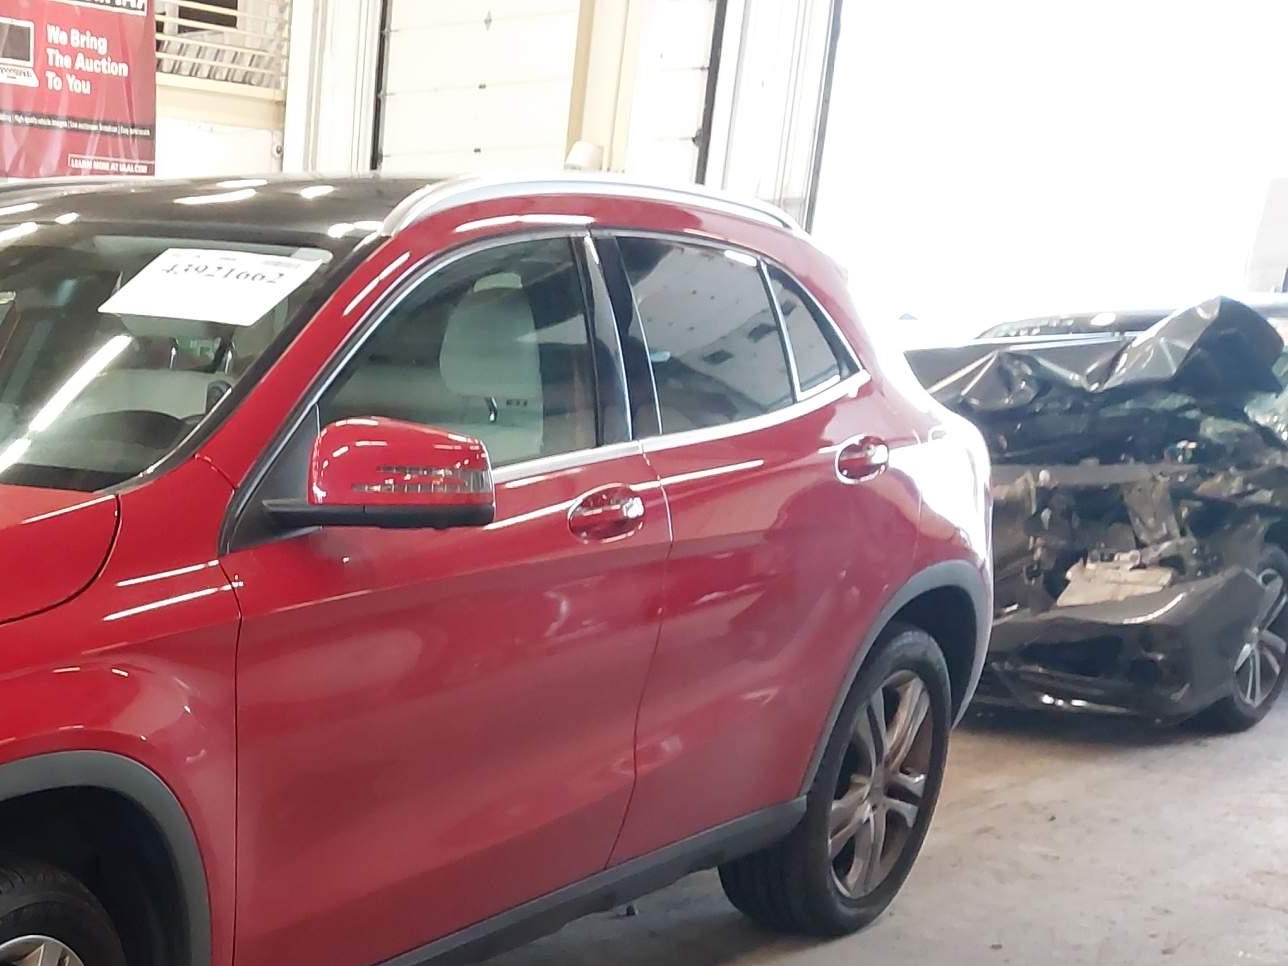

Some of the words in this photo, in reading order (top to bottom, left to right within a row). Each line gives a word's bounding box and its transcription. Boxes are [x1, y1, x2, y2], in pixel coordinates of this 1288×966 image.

[46, 24, 68, 46] We
[70, 28, 108, 55] Bring
[46, 48, 72, 69] The
[73, 52, 129, 77] Auction
[45, 70, 63, 91] To
[65, 73, 91, 95] You
